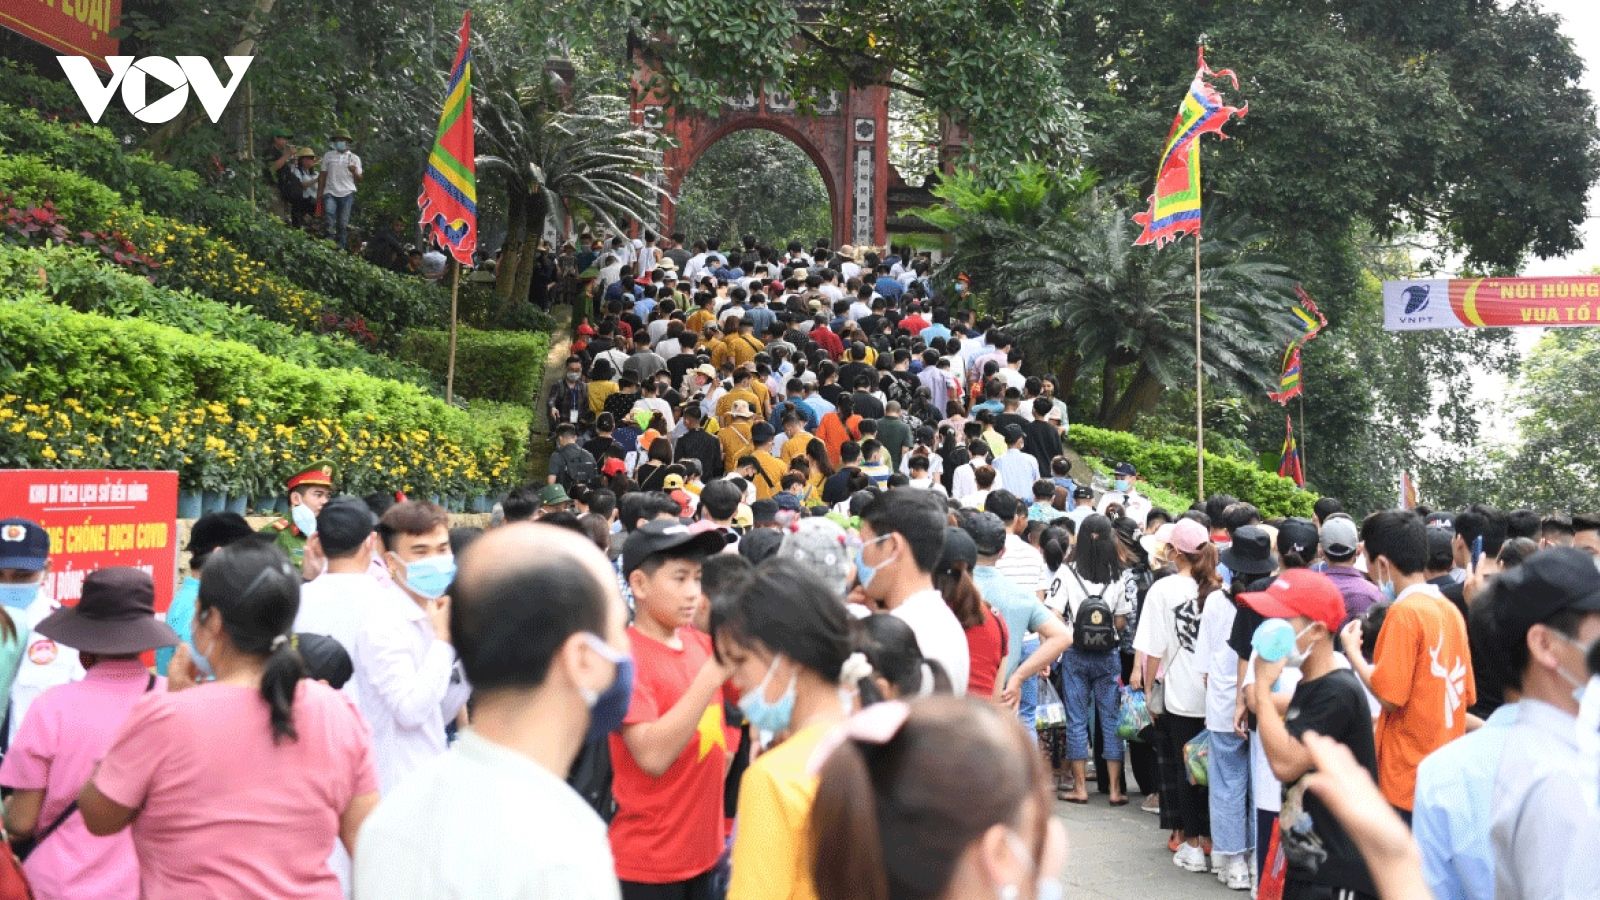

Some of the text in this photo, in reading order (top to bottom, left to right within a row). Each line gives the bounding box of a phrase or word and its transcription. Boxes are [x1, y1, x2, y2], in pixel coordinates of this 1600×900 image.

[1399, 315, 1433, 323] VNPT
[1521, 307, 1559, 322] VUA
[66, 515, 106, 553] CHỐNG
[108, 523, 135, 557] DỊCH
[137, 522, 168, 549] COVID
[1084, 632, 1108, 646] MK
